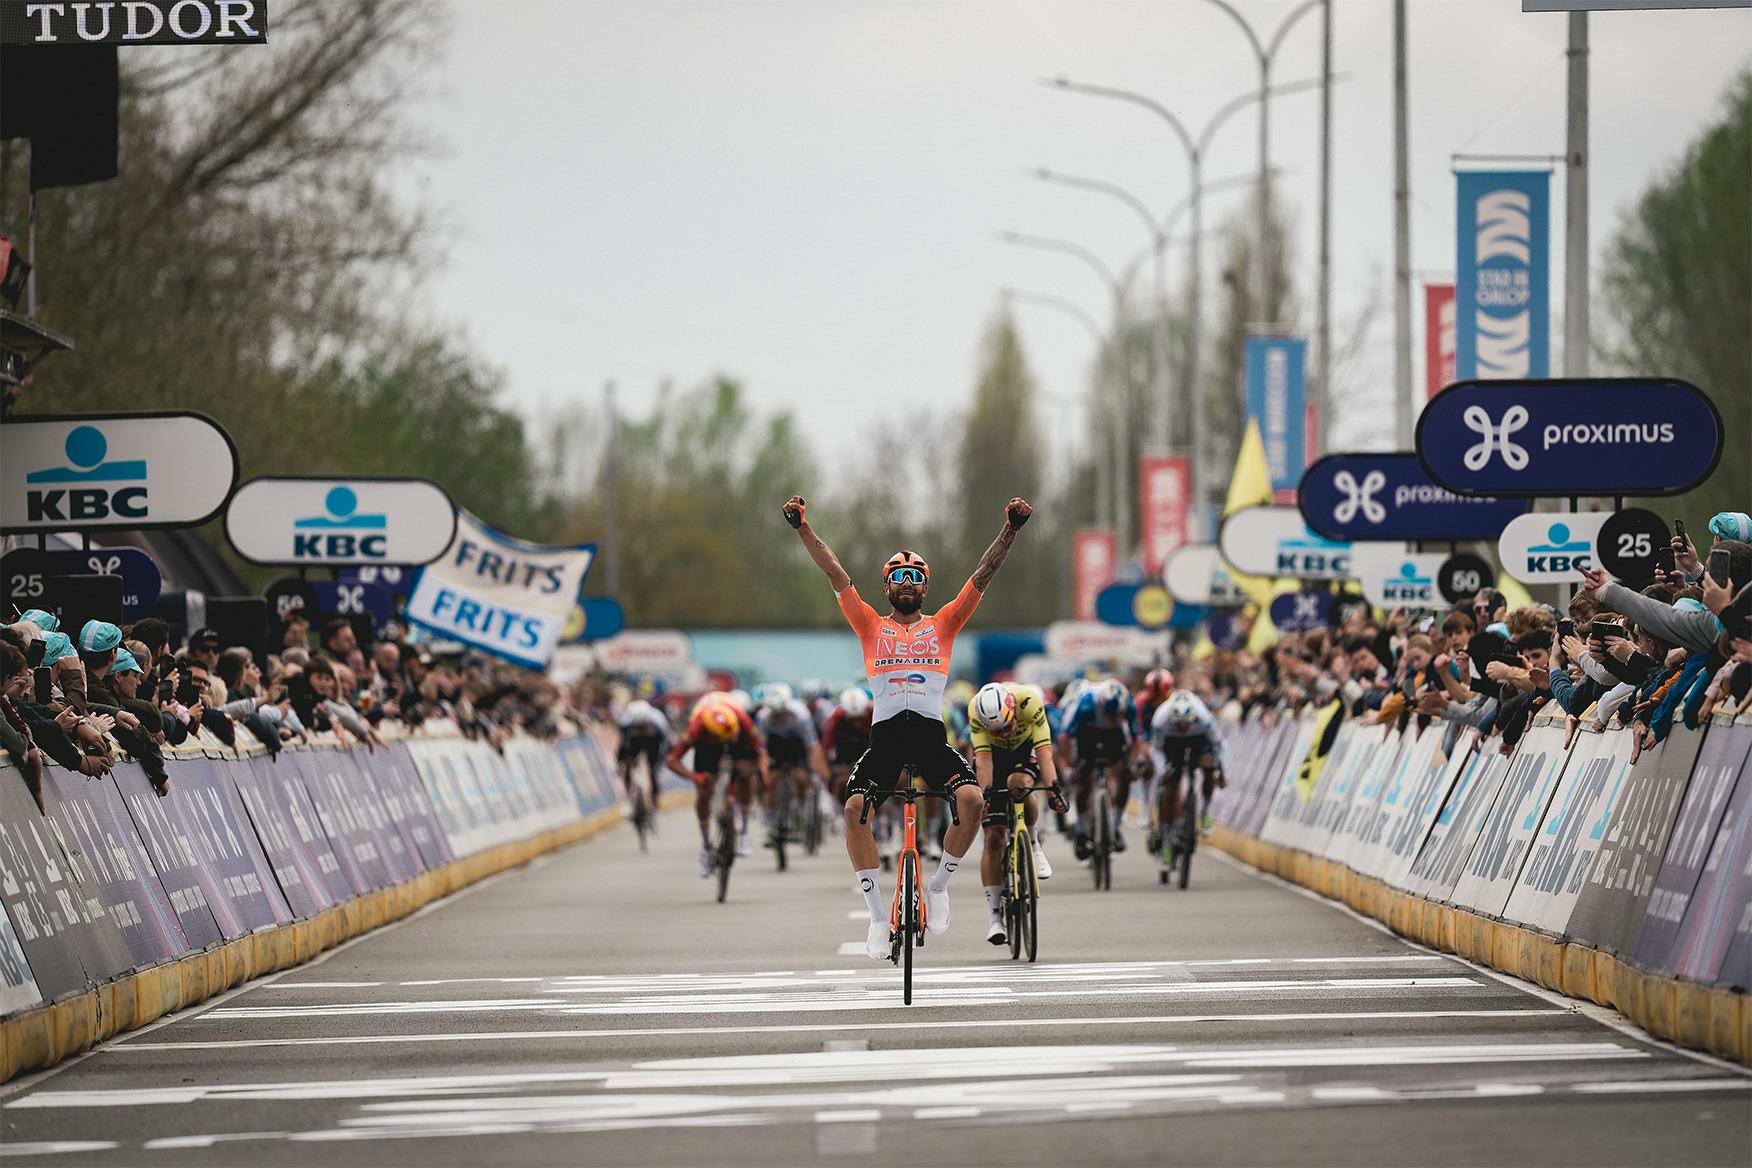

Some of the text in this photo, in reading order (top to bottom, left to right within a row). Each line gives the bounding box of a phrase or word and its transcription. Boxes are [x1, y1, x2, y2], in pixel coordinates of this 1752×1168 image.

[26, 0, 259, 42] TUDOR
[1543, 422, 1675, 450] proximus
[26, 487, 149, 522] KBC
[293, 534, 387, 558] KBC
[1617, 533, 1652, 558] 25
[455, 540, 567, 595] FRITS
[1277, 552, 1350, 573] KBC
[1527, 555, 1592, 573] KBC
[10, 573, 44, 598] 25
[1451, 569, 1480, 591] 50
[1383, 586, 1432, 600] KBC
[431, 588, 543, 649] FRITS
[876, 636, 940, 656] INEOS
